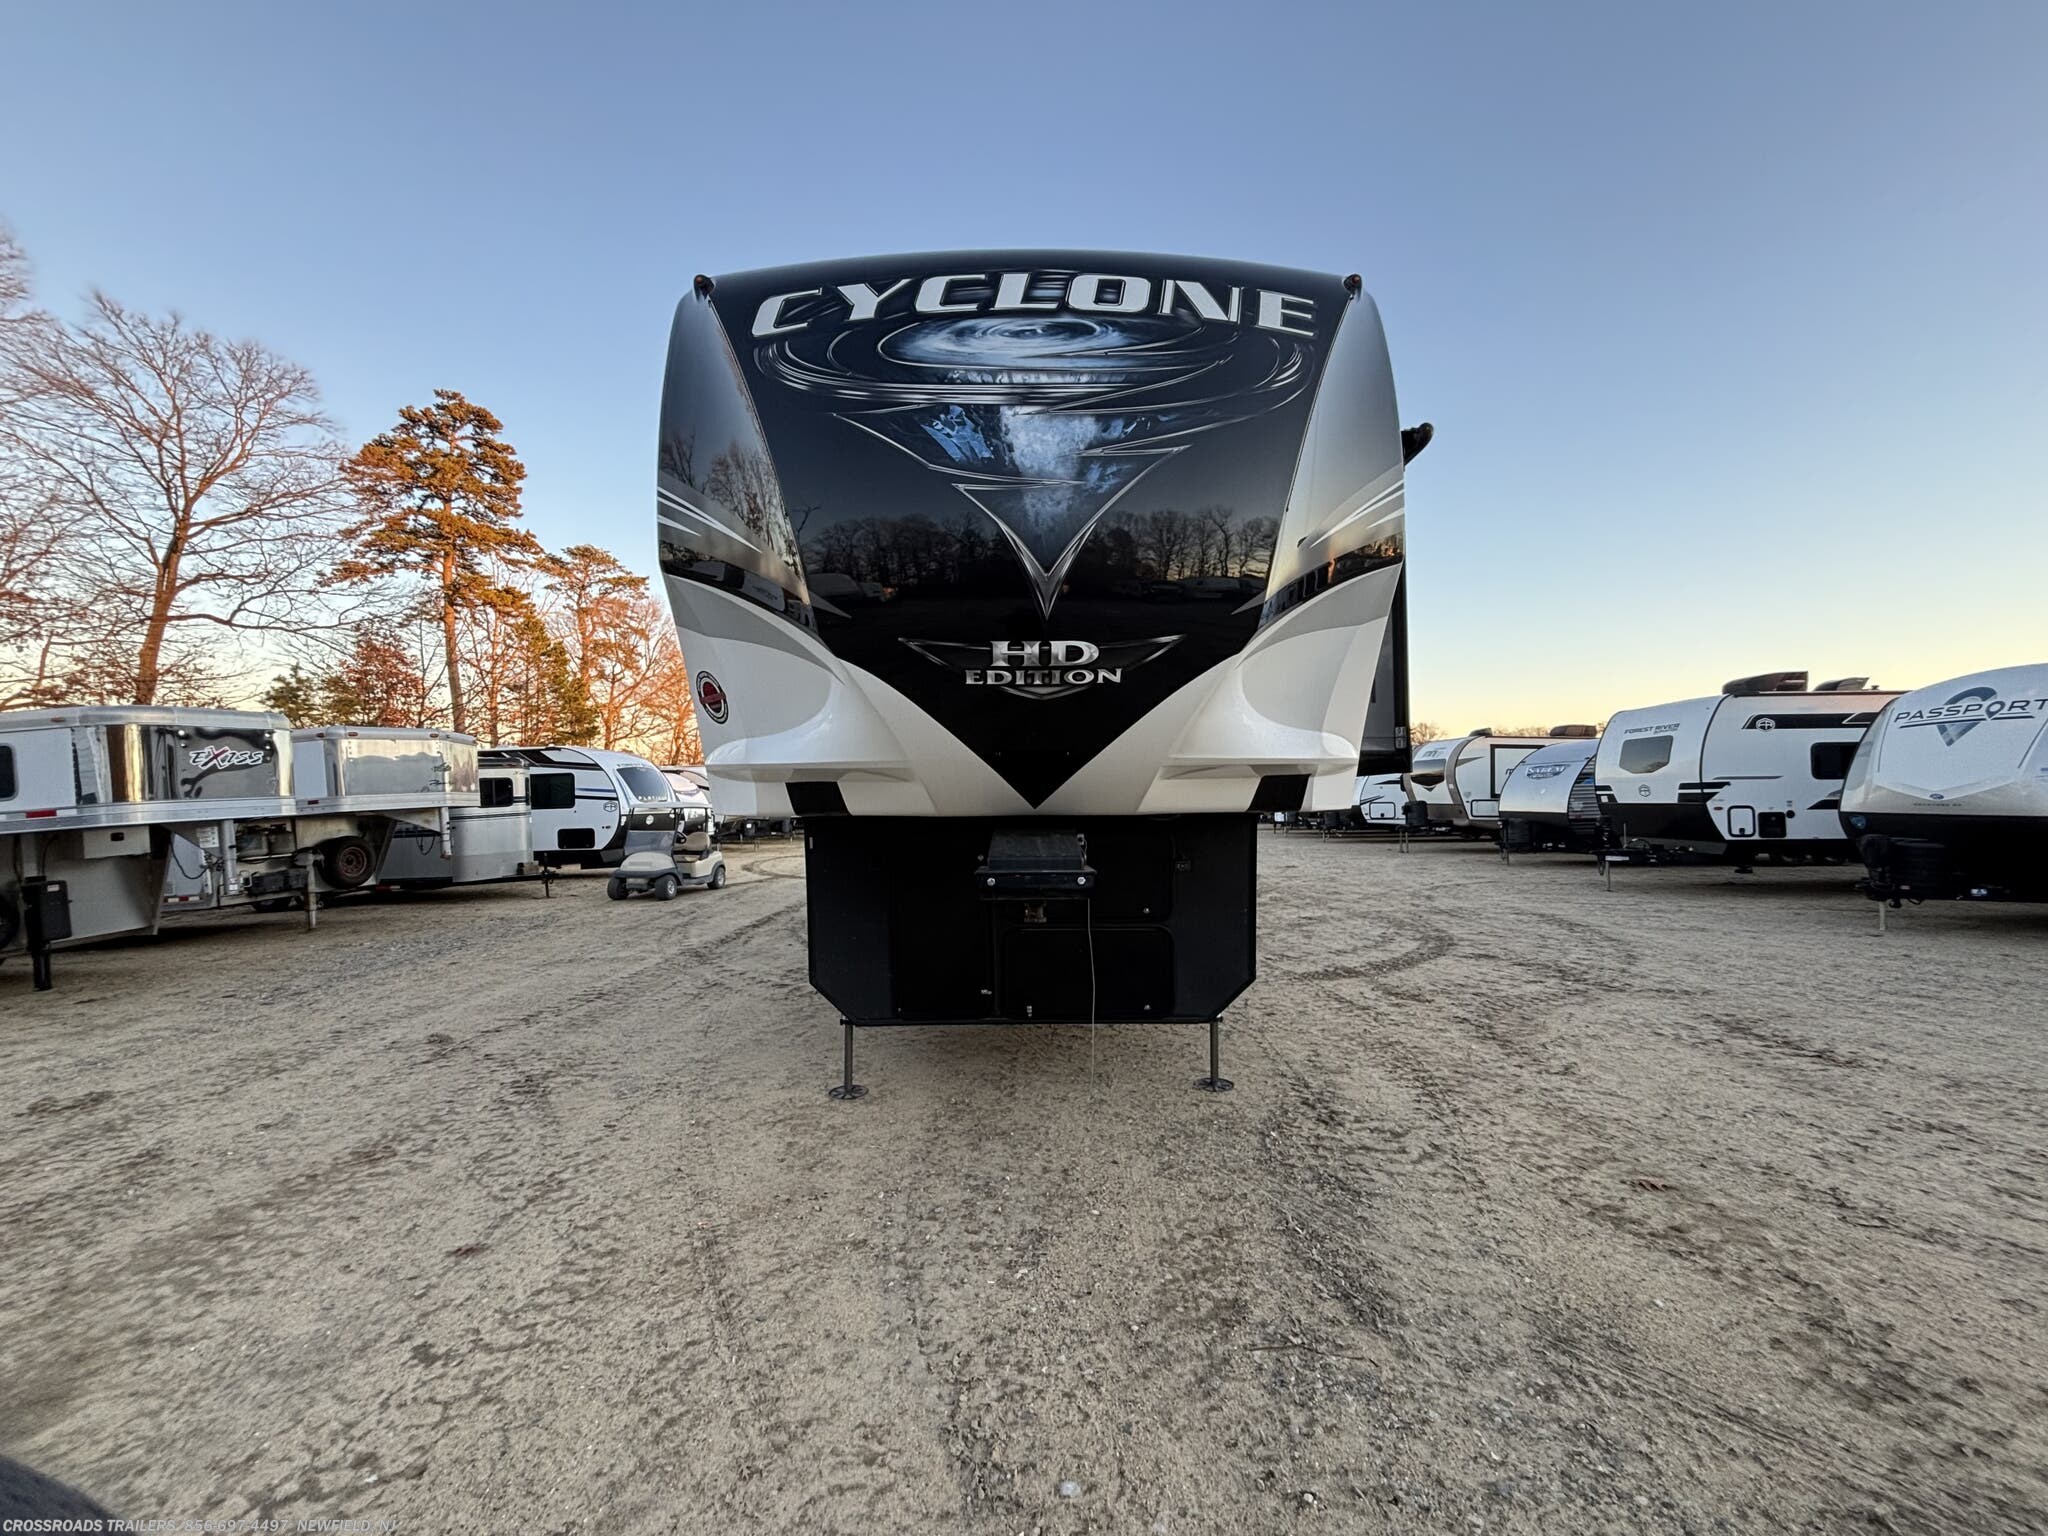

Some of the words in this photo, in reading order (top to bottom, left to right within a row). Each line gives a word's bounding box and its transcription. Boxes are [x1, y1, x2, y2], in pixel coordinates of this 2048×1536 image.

[751, 272, 1316, 337] CYCLONE
[990, 640, 1100, 667] HD
[965, 668, 1123, 685] EDITION
[1894, 699, 2048, 723] PASSPORT
[1624, 726, 1654, 734] FOREST
[1655, 722, 1680, 731] RIVER
